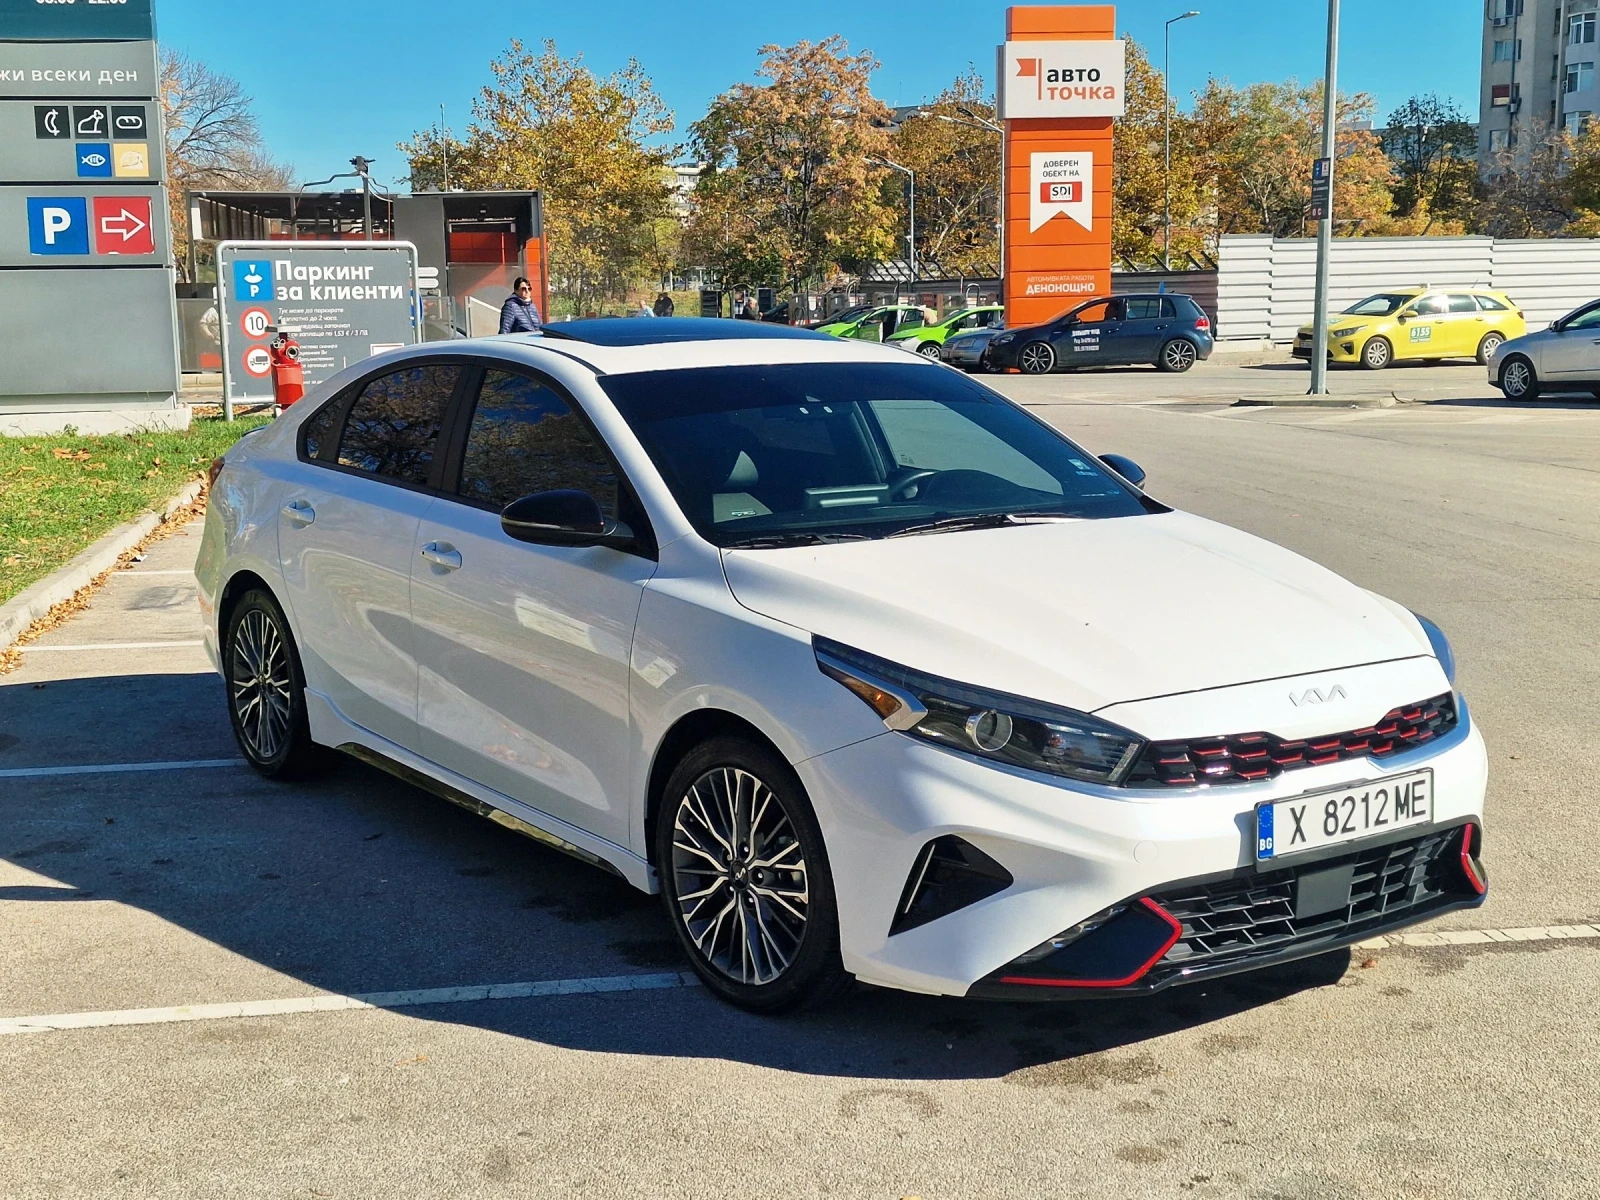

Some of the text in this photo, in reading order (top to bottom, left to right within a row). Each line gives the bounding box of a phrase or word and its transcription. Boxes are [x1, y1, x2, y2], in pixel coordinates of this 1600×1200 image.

[31, 69, 91, 82] всеки
[98, 69, 137, 85] ден
[1046, 68, 1101, 83] авто
[1046, 85, 1115, 100] точка
[1043, 160, 1079, 168] ДОВЕРЕН
[1052, 186, 1071, 196] SDI
[43, 207, 71, 244] P
[275, 260, 374, 285] Паркинг
[277, 285, 404, 301] за клиенти
[1026, 283, 1096, 295] ДЕНОНОЩНО
[249, 316, 264, 331] 10
[1411, 326, 1431, 337] 6155
[1289, 779, 1426, 845] X 8212 ME
[1259, 837, 1273, 851] BG
